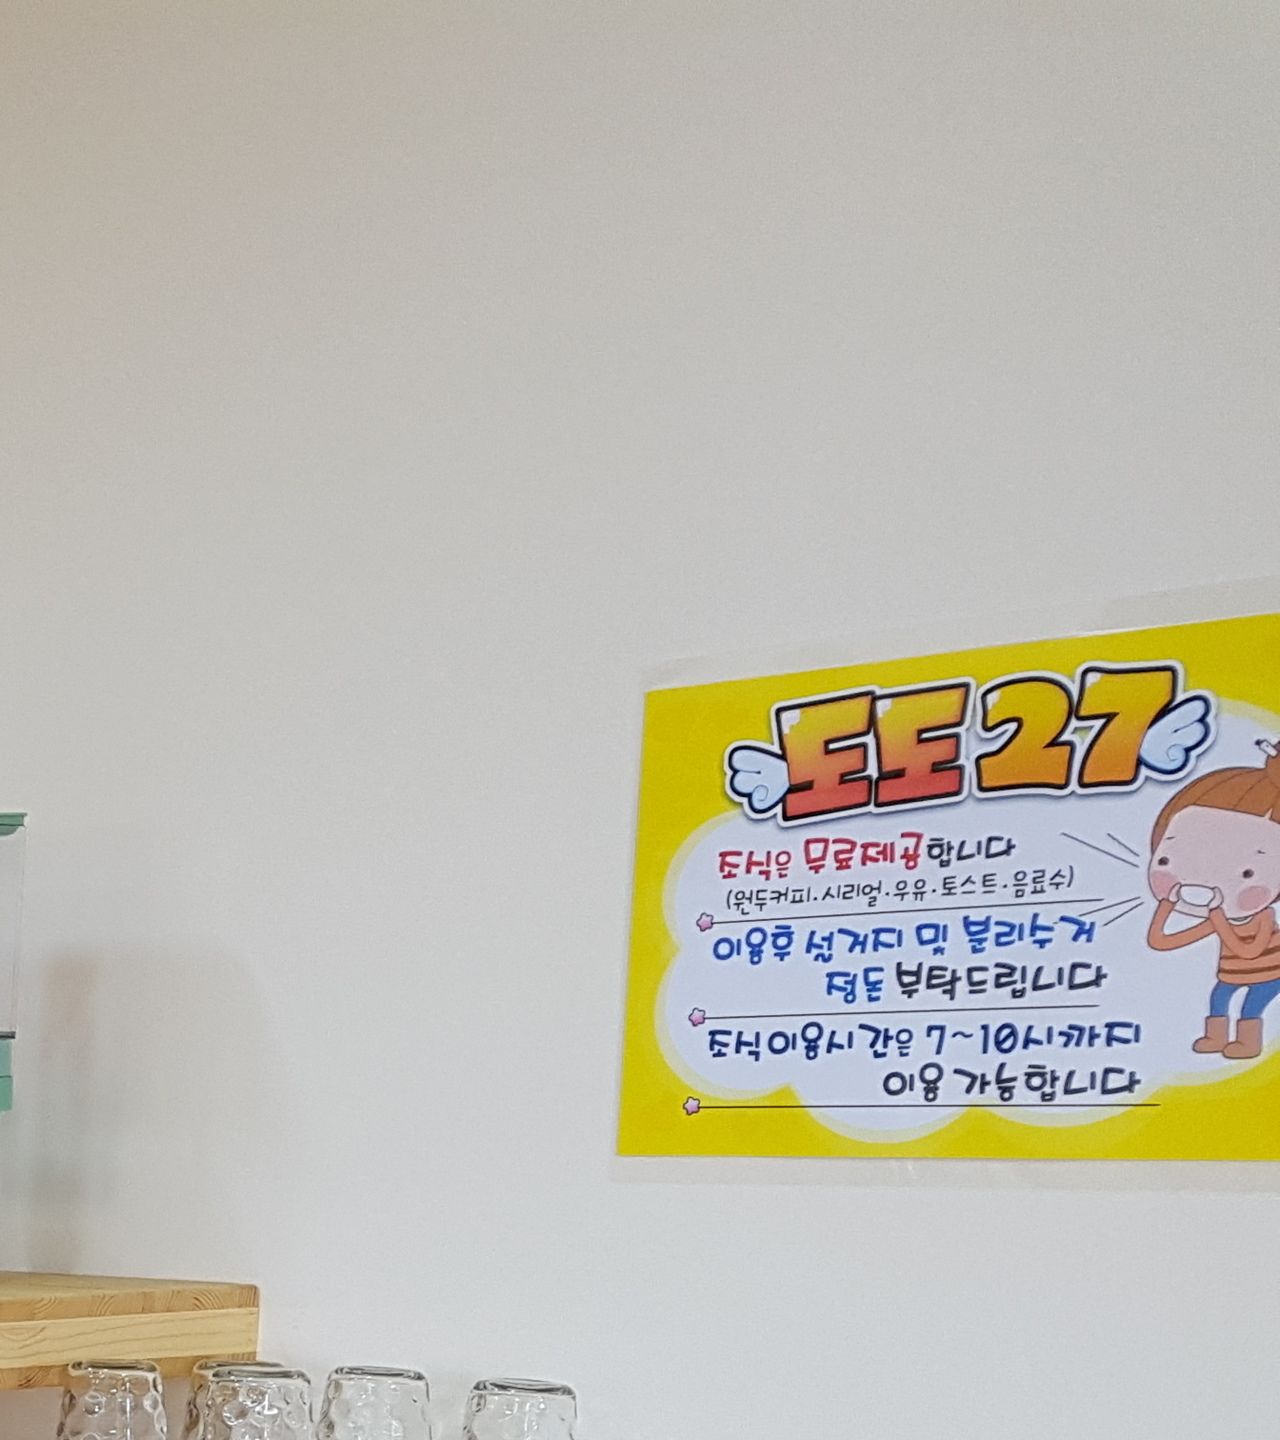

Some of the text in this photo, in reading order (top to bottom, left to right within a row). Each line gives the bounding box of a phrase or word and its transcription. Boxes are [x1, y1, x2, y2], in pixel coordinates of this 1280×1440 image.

[718, 832, 1016, 881] 조식은 무료제공합니다
[713, 912, 1096, 965] 이용후 설거지 및 분리수거
[826, 962, 1108, 1004] 정돈 부탁드립니다
[883, 1062, 1142, 1102] 이용 가능합니다
